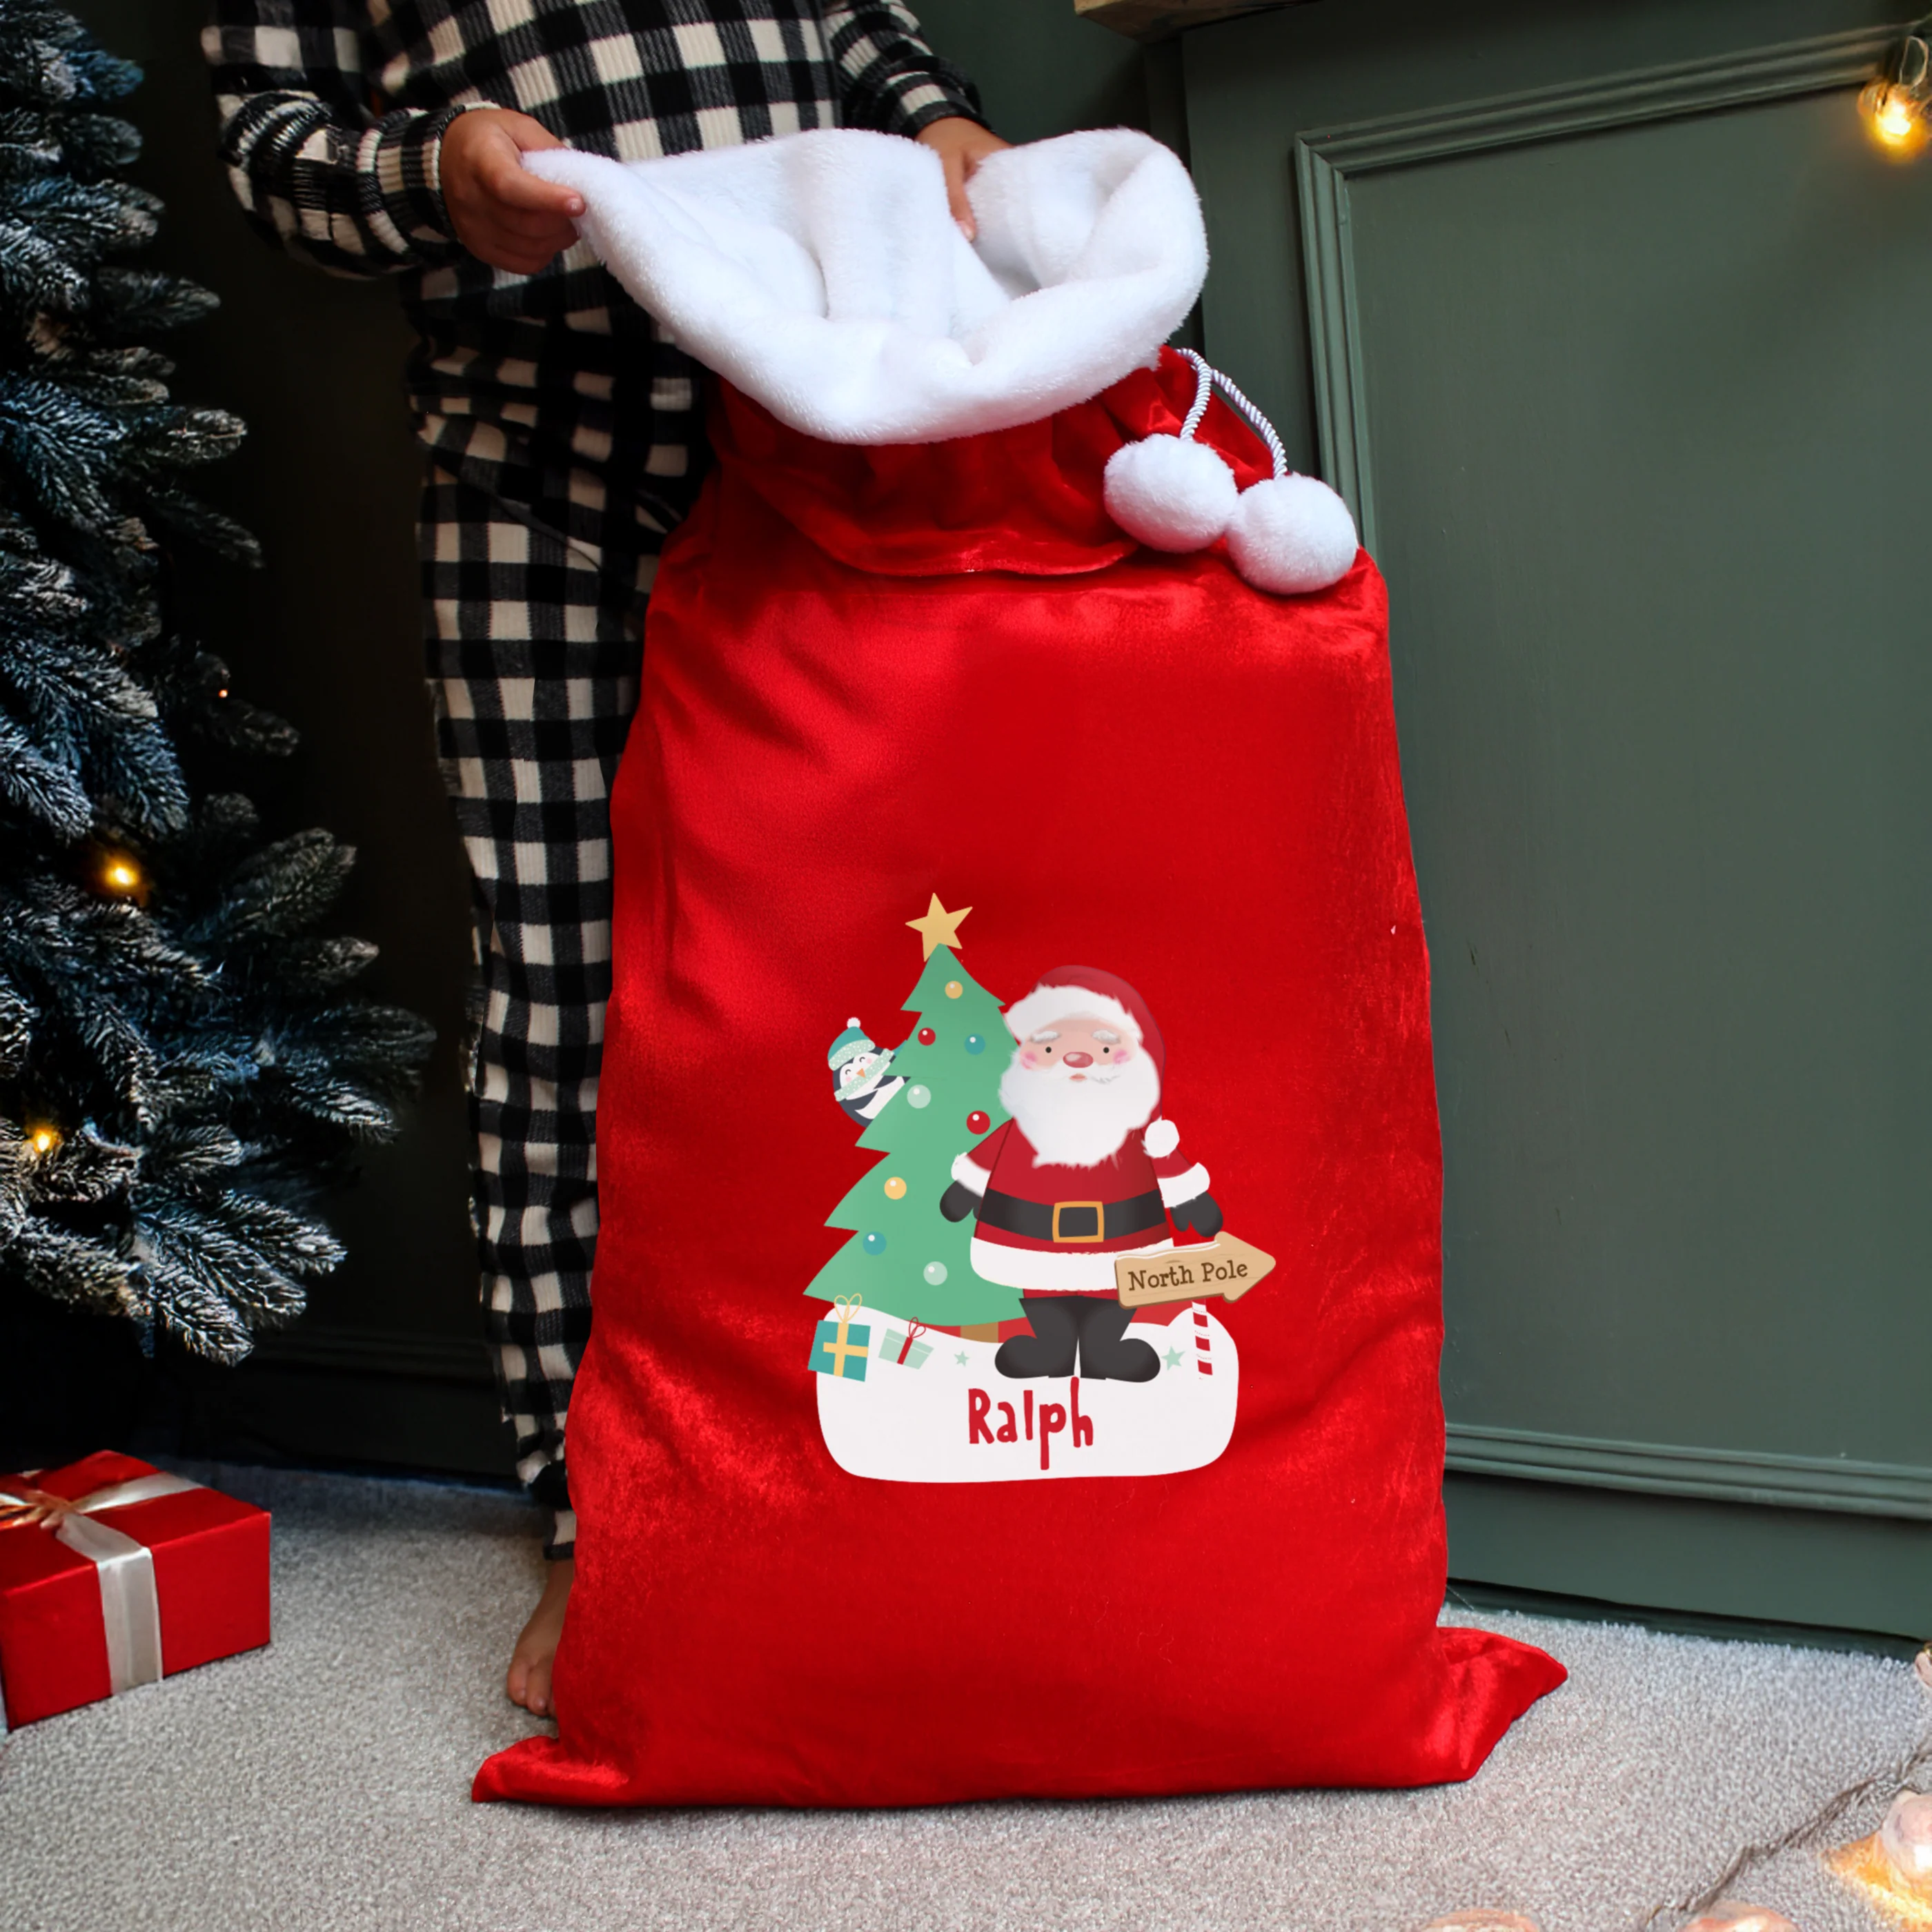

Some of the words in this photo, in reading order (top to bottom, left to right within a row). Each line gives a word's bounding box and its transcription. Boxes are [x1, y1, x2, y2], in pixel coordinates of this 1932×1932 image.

[1127, 1265, 1194, 1292] North
[1201, 1259, 1248, 1283] Pole
[968, 1376, 1094, 1470] Ralph
